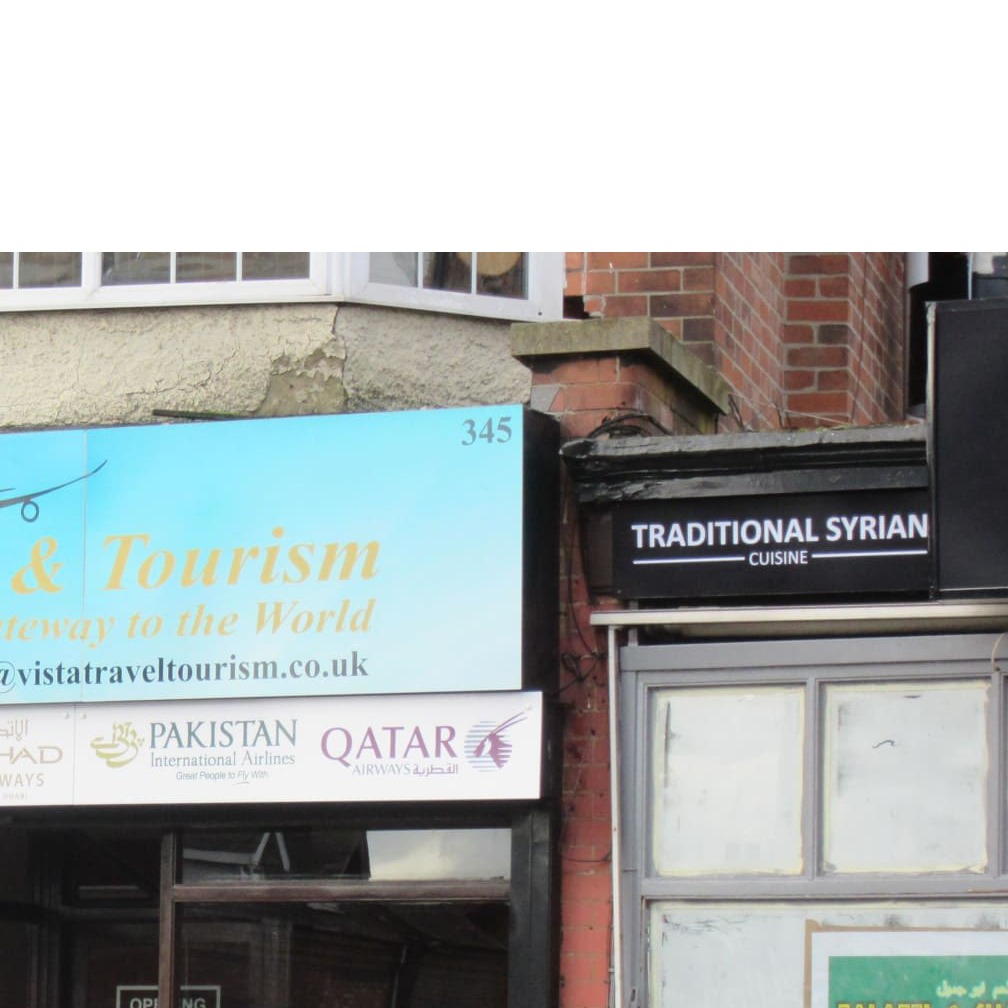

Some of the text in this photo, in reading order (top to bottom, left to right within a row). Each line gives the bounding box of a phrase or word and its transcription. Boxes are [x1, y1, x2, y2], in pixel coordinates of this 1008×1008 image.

[461, 417, 513, 446] 345
[631, 513, 928, 548] TRADITIONAL SYRIAN
[10, 536, 64, 594] &
[101, 527, 381, 592] Tourism
[749, 551, 808, 566] CUISINE
[127, 611, 163, 639] to
[176, 605, 239, 637] the
[256, 598, 377, 635] World
[150, 719, 298, 749] PAKISTAN
[321, 725, 457, 768] QATAR
[151, 750, 295, 767] International Airlines
[353, 763, 410, 775] AIRWAYS
[176, 771, 198, 781] Great
[199, 770, 227, 782] People
